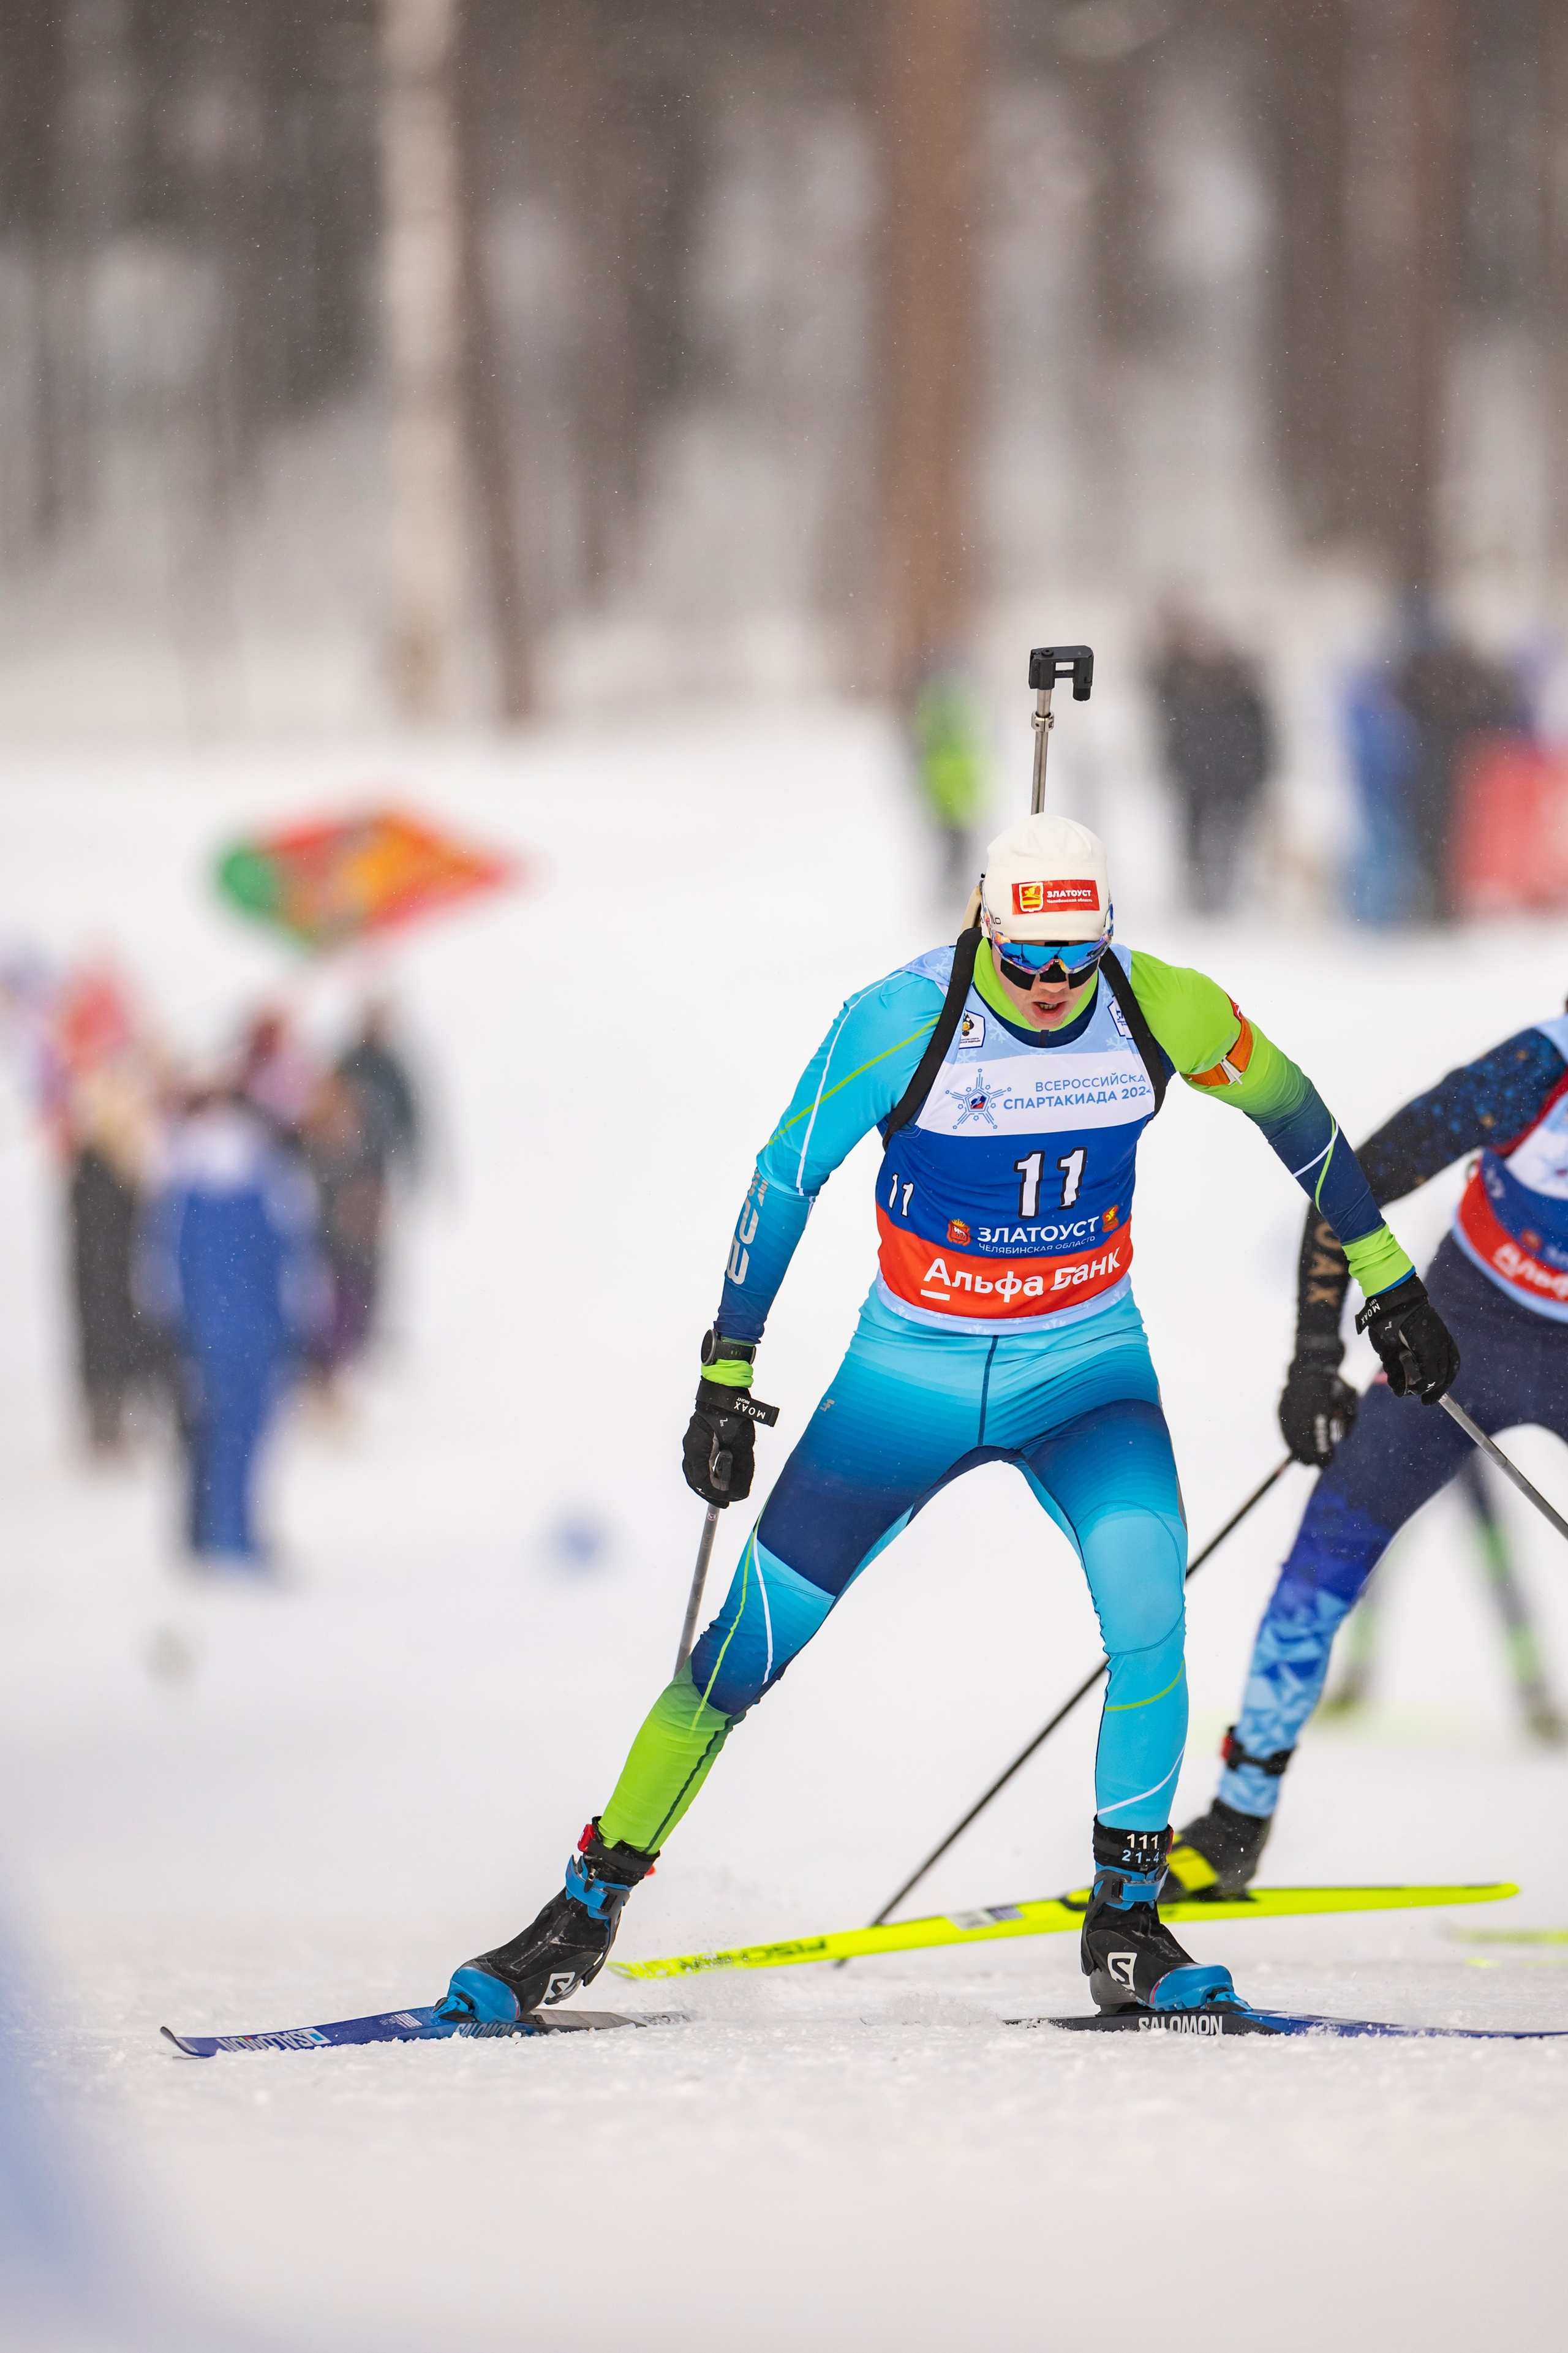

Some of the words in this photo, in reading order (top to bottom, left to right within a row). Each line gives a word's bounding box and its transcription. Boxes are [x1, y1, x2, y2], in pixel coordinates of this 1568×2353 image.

[1046, 889, 1091, 898] ЗЛАТОУСТ
[1035, 1073, 1146, 1092] ВСЕРОССИЙСКА
[1003, 1090, 1118, 1110] СПАРТАКИАДА
[1014, 1146, 1088, 1219] 11
[889, 1172, 914, 1218] 11
[977, 1216, 1099, 1243] ЗЛАТОУСТ
[978, 1243, 1053, 1254] ЧЕЛЯБИНСКАЯ
[1055, 1236, 1095, 1250] ОБЛАСТЬ
[923, 1258, 1044, 1303] Альфа
[1050, 1246, 1121, 1291] Банк
[1307, 1221, 1344, 1307] OAX
[1360, 1303, 1381, 1325] MOAX
[734, 1401, 766, 1419] MOAX
[1126, 1834, 1158, 1849] 111
[1138, 2015, 1223, 2034] SALOMON
[216, 2030, 314, 2052] SALOMON
